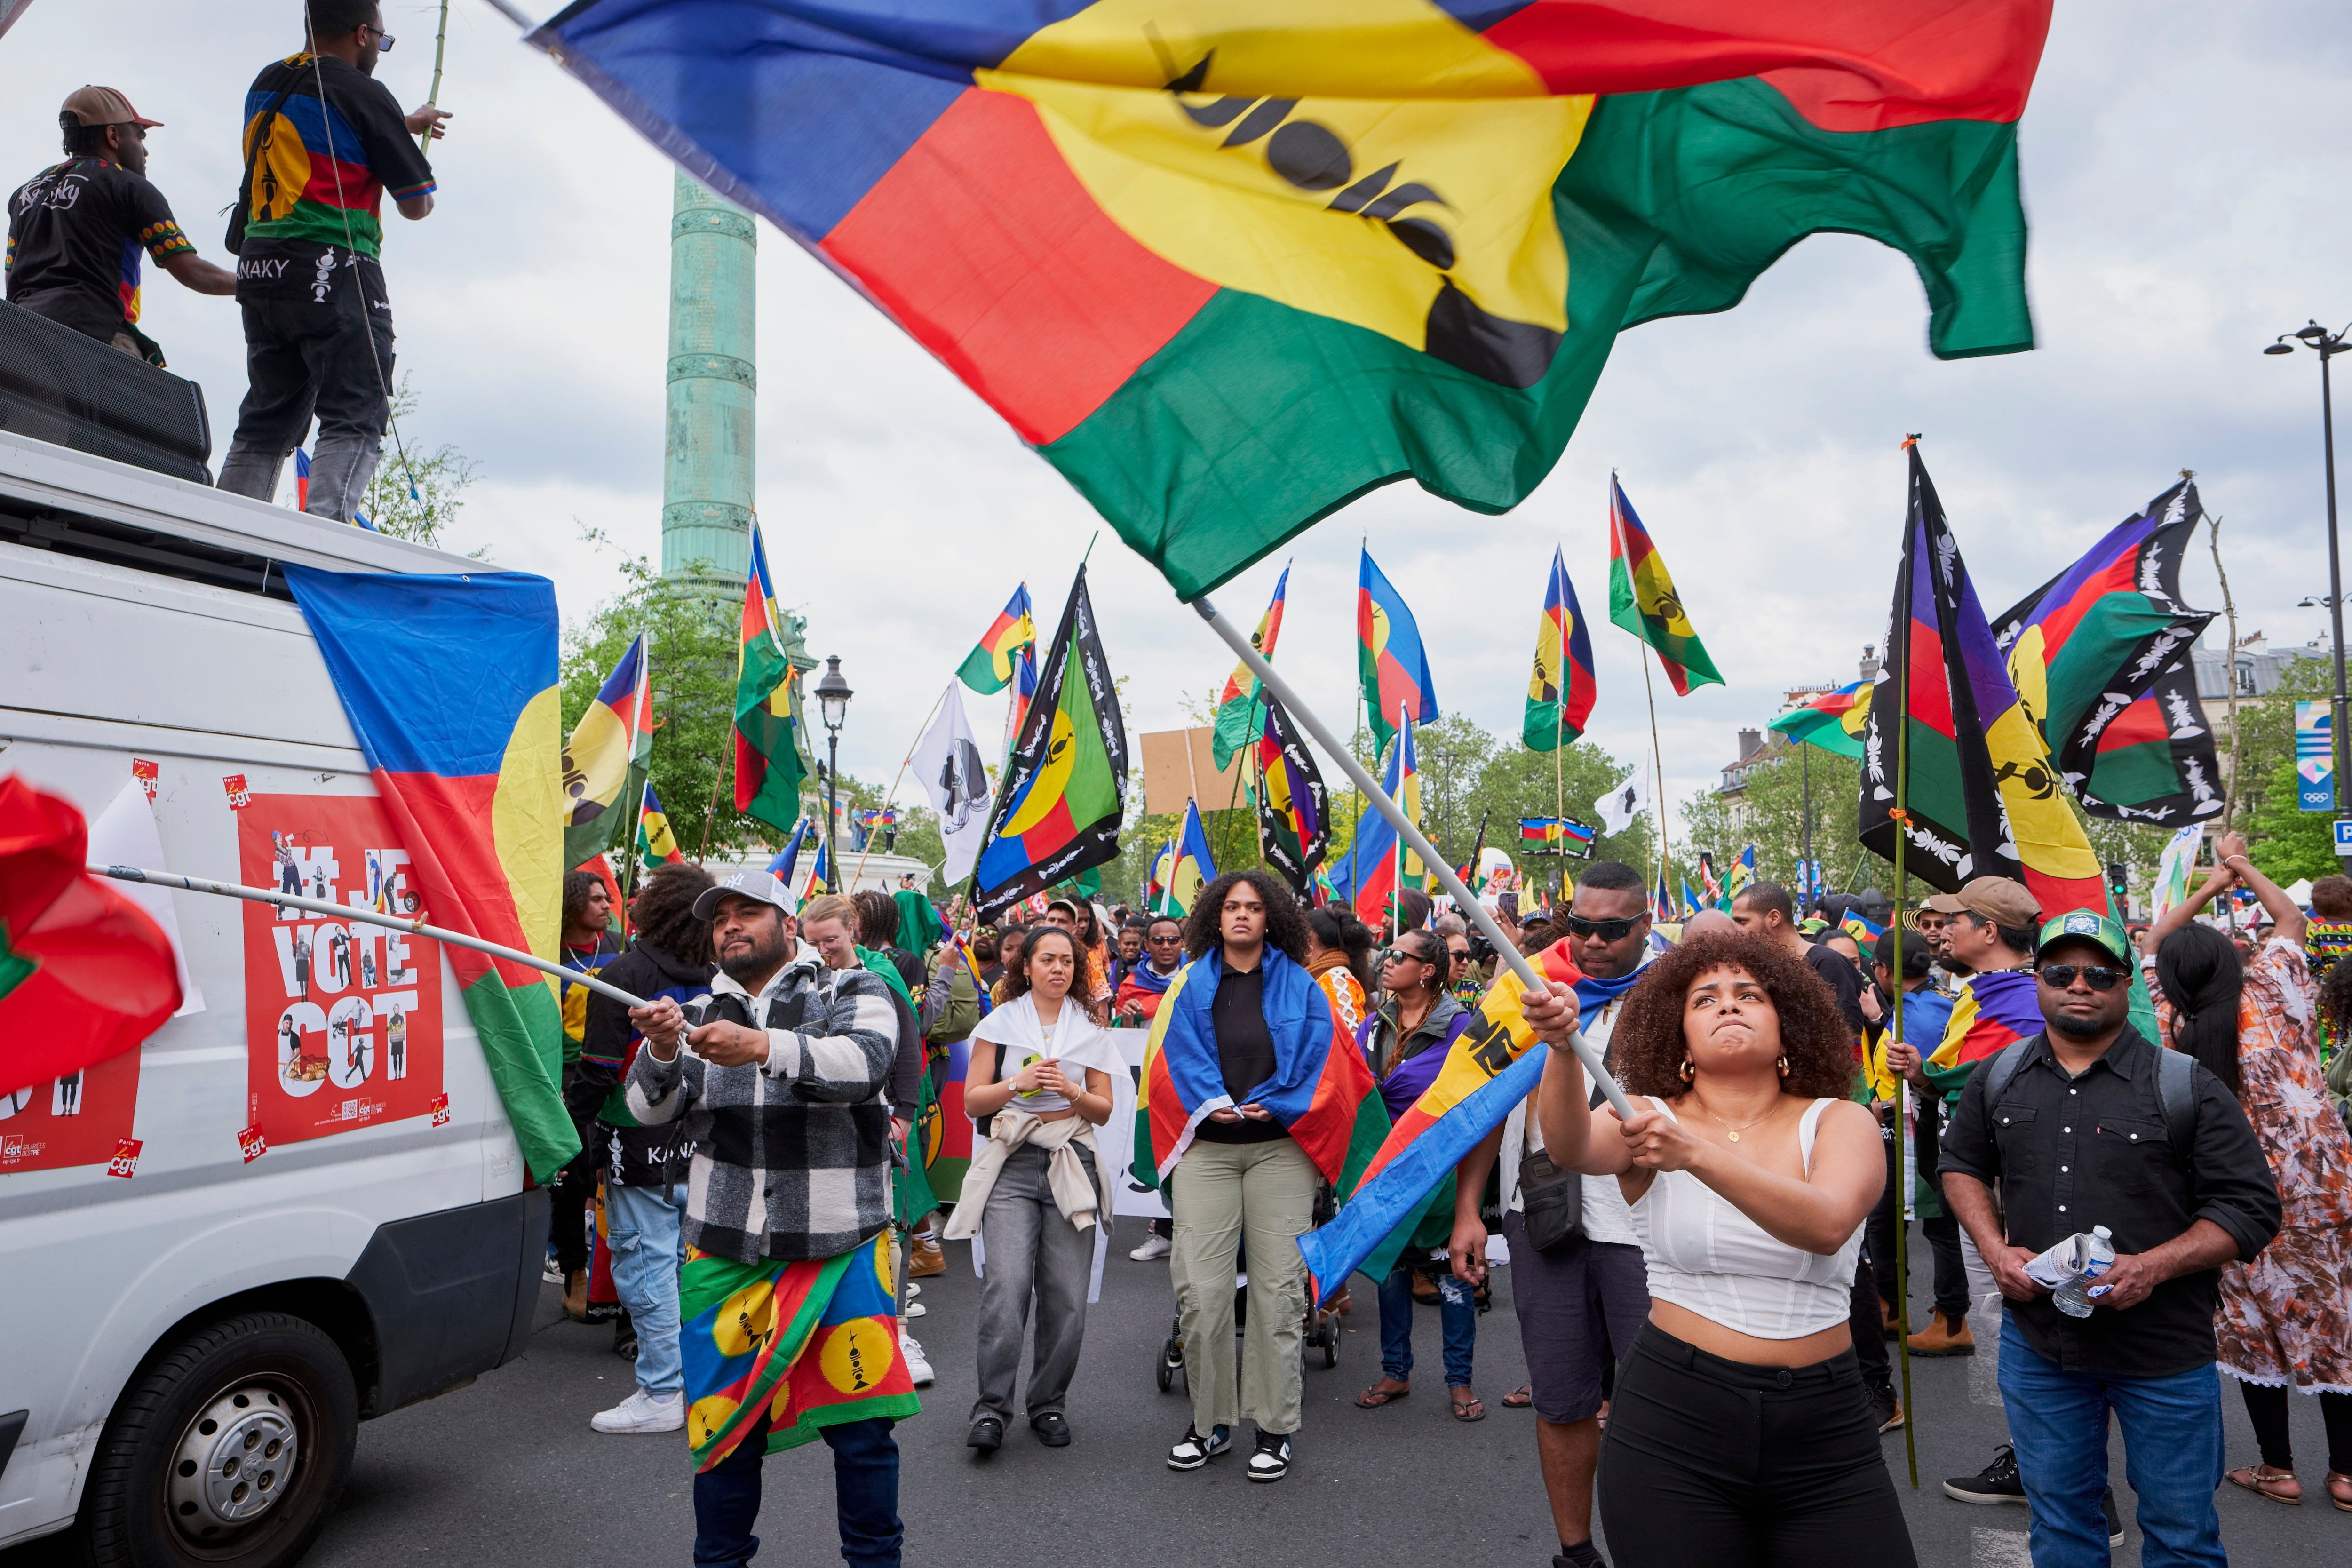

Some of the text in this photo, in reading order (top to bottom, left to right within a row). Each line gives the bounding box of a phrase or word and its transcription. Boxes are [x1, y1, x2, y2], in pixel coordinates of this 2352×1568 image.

[227, 783, 241, 794] la
[228, 788, 251, 807] cgt
[2343, 825, 2352, 841] P
[272, 919, 418, 998] VOTE
[278, 990, 419, 1097] CGT
[359, 1106, 370, 1114] cgt
[432, 1102, 442, 1113] la
[432, 1105, 450, 1123] cgt
[239, 1128, 254, 1138] Paris
[242, 1135, 254, 1148] la
[242, 1135, 266, 1158] cgt
[5, 1145, 21, 1156] cgt
[114, 1146, 130, 1158] la
[110, 1156, 138, 1175] cgt
